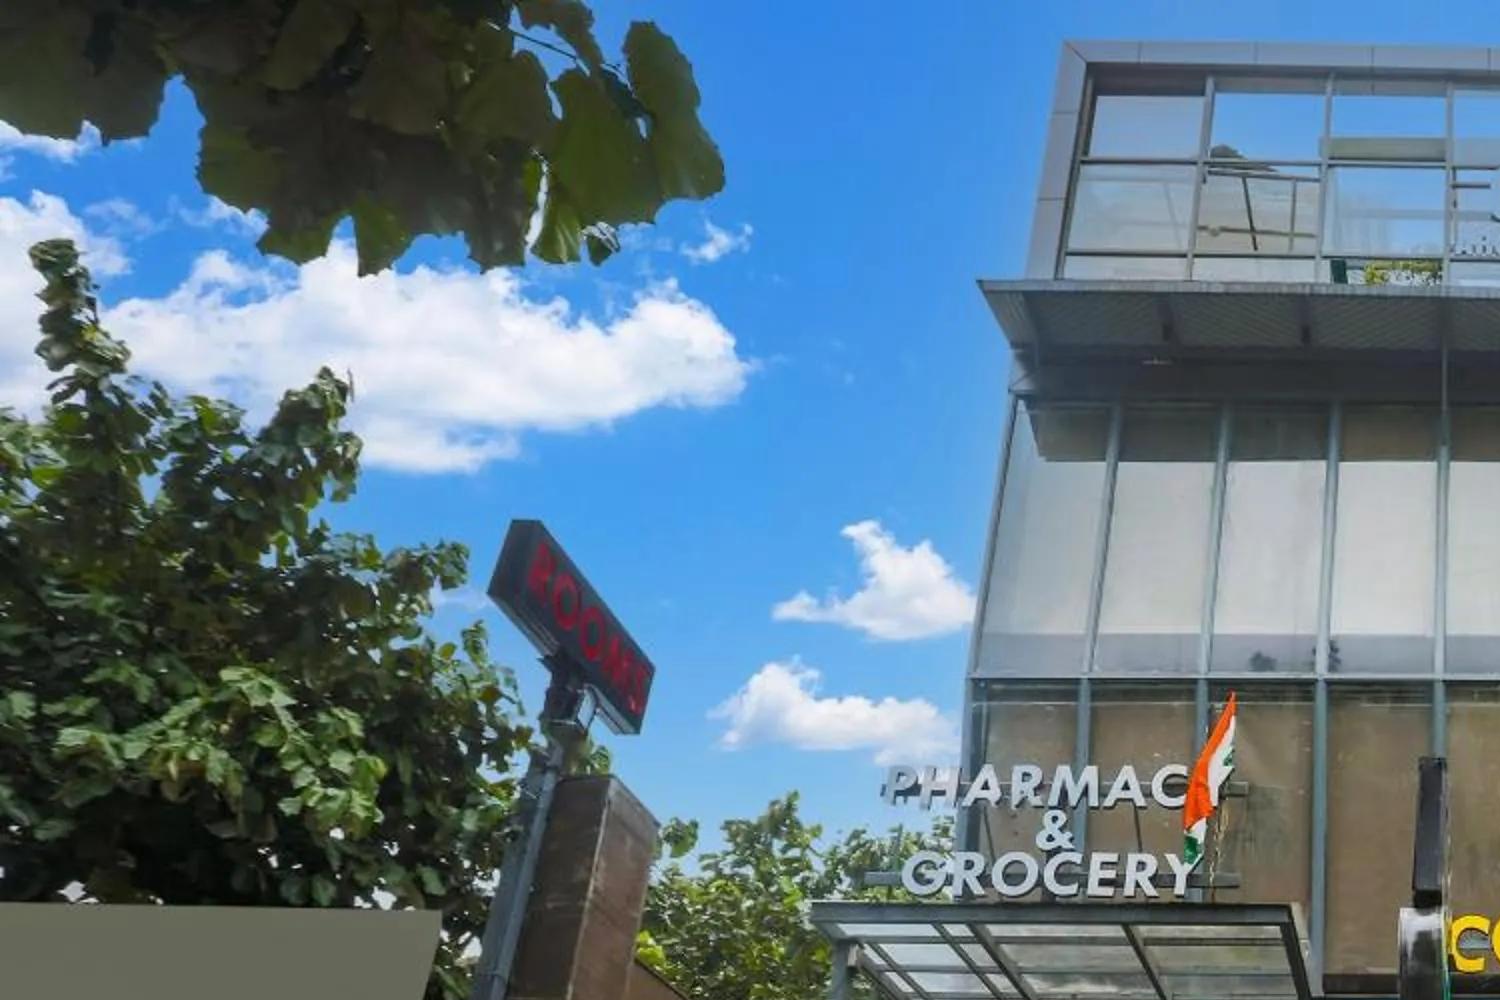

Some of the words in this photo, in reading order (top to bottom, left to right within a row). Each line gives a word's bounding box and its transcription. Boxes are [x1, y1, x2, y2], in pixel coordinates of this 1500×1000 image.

[526, 540, 650, 717] ROOMS
[1034, 809, 1075, 852] &
[901, 851, 1196, 898] GROCERY
